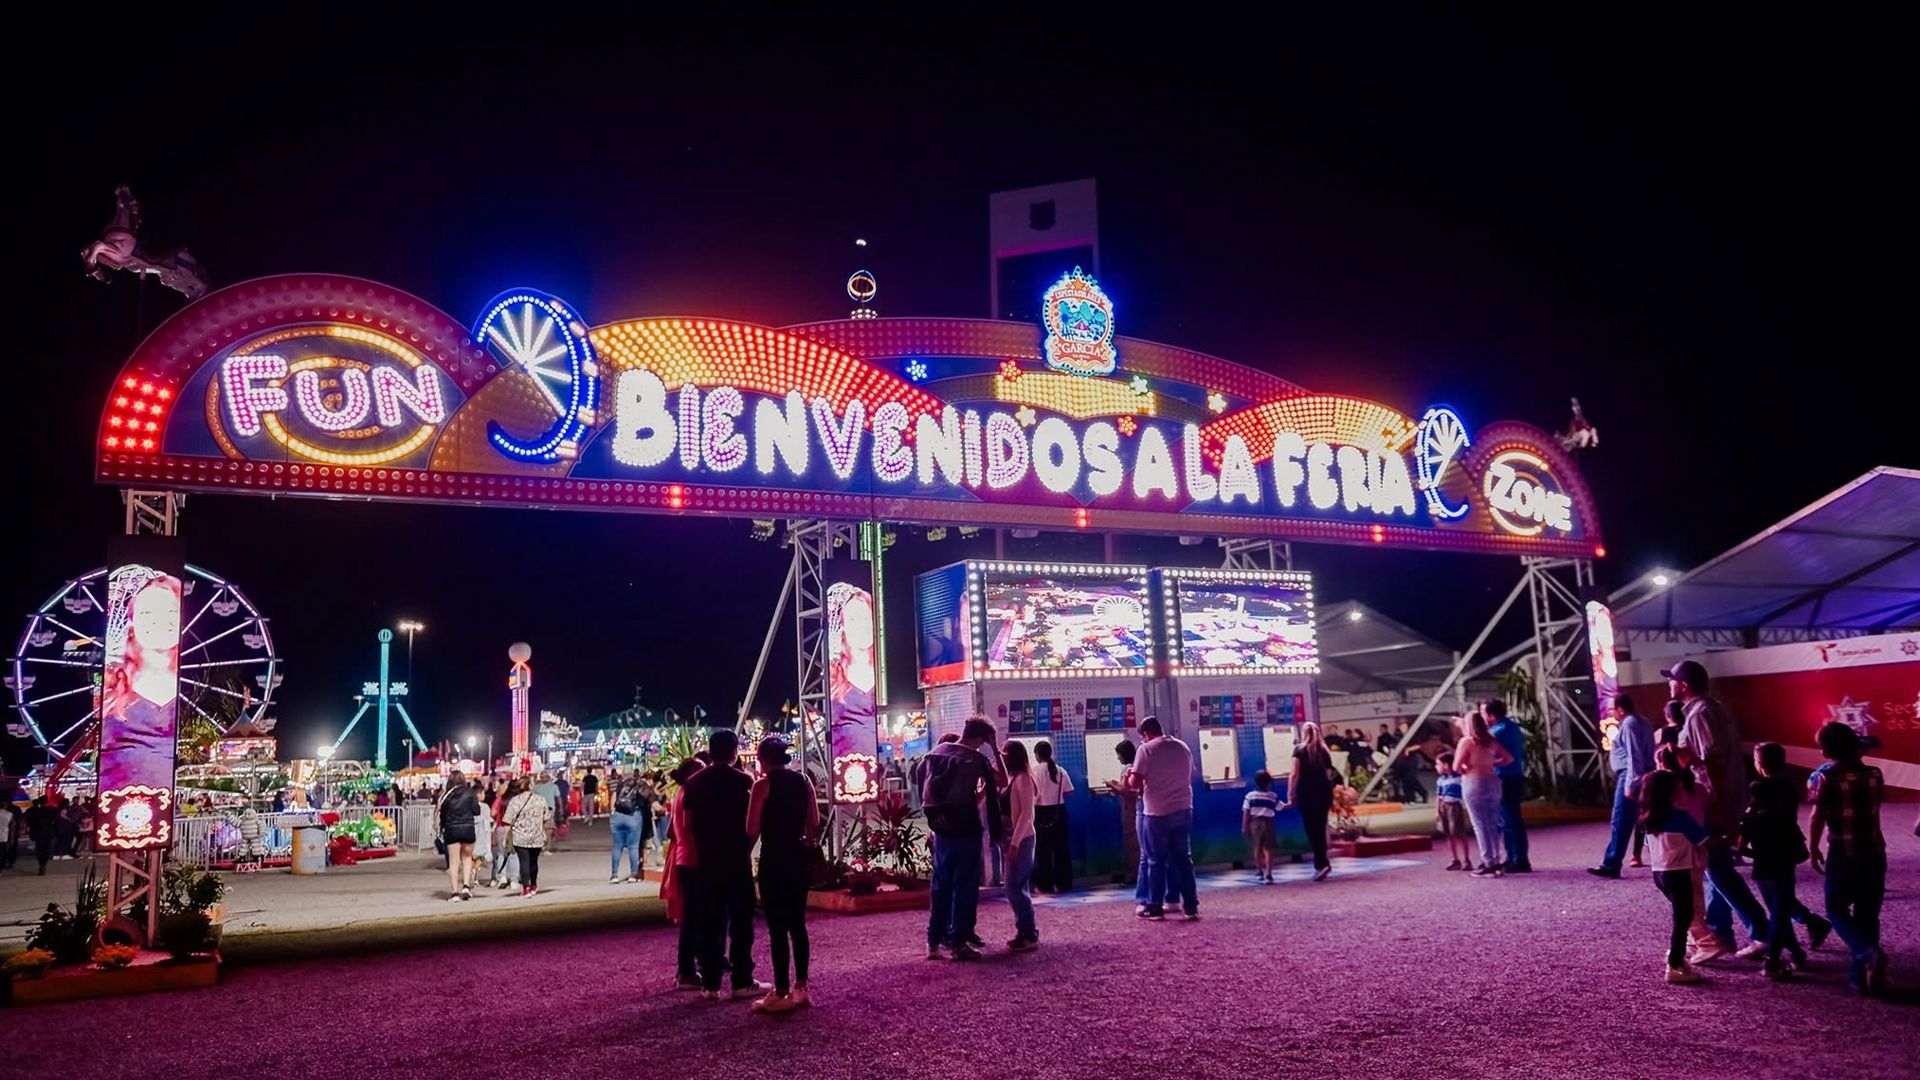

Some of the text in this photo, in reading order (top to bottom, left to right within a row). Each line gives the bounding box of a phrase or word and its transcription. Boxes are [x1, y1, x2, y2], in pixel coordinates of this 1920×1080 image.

[222, 354, 445, 437] FUN
[612, 368, 1417, 516] BIENVENIDOS A LA FERIA
[1488, 461, 1573, 532] ZONE
